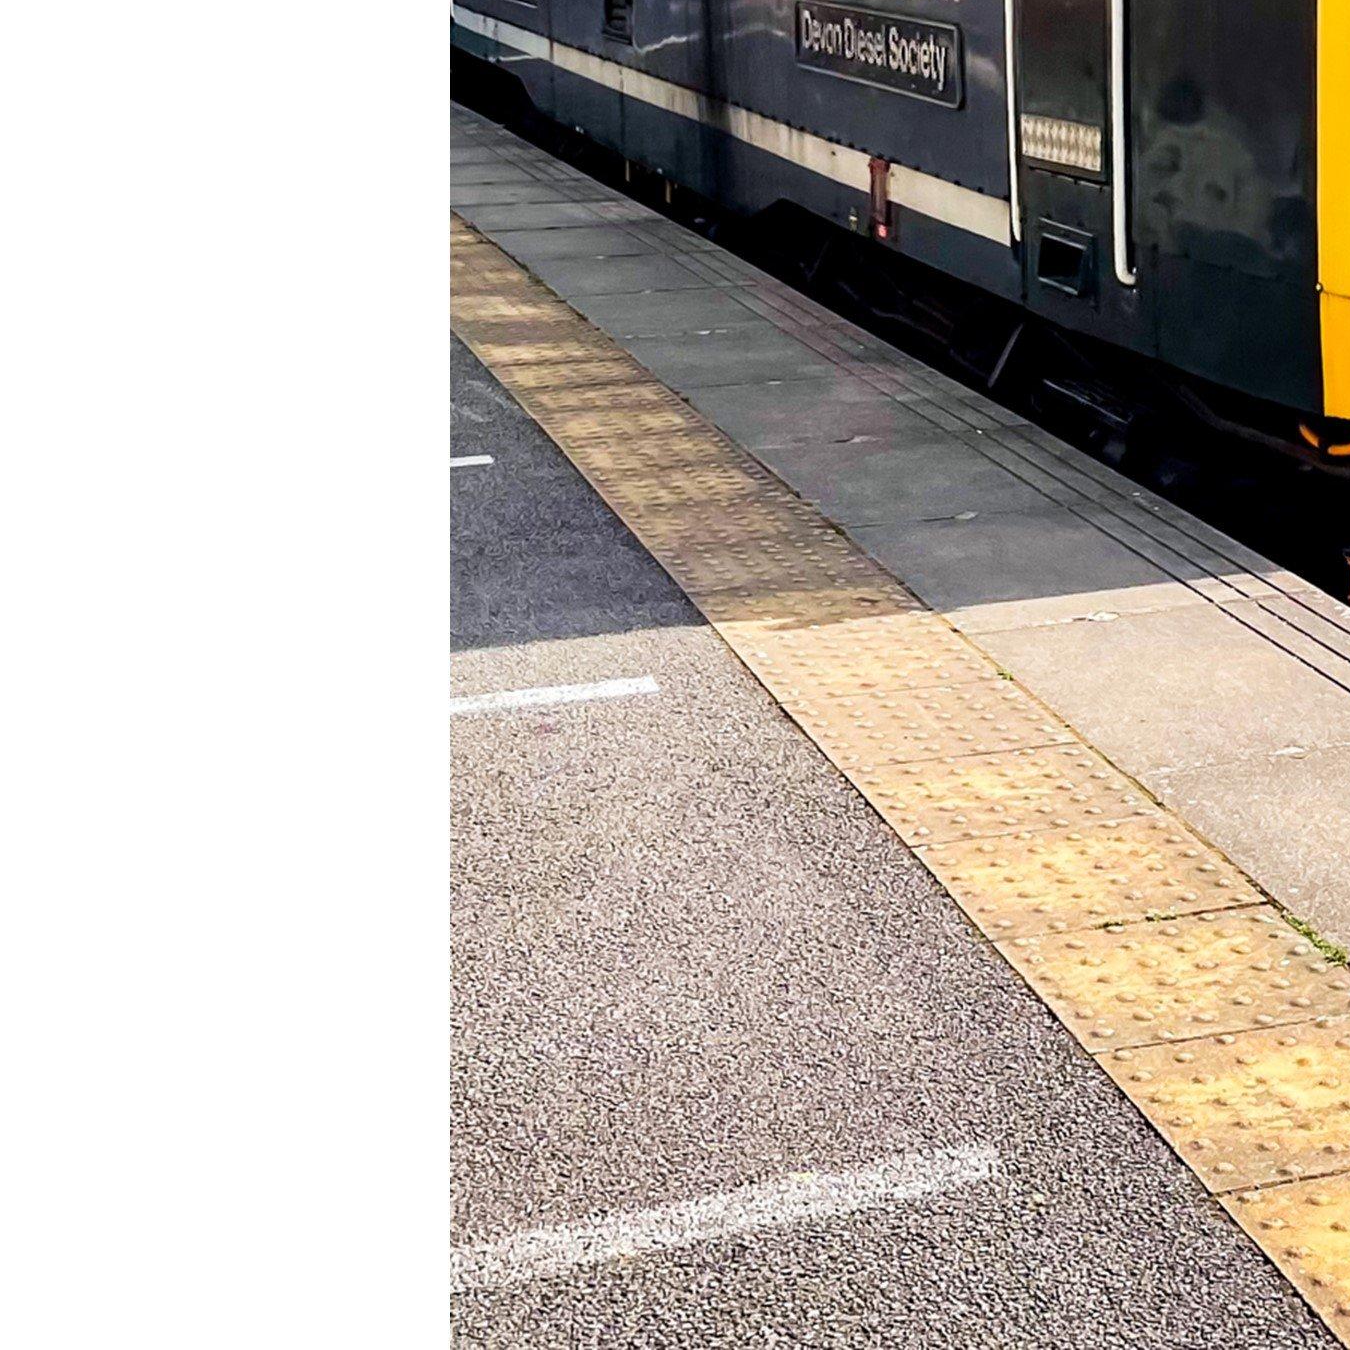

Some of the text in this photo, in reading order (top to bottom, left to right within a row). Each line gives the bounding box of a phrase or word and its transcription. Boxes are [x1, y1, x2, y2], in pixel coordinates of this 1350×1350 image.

[801, 9, 947, 92] Devon Diesel Society
